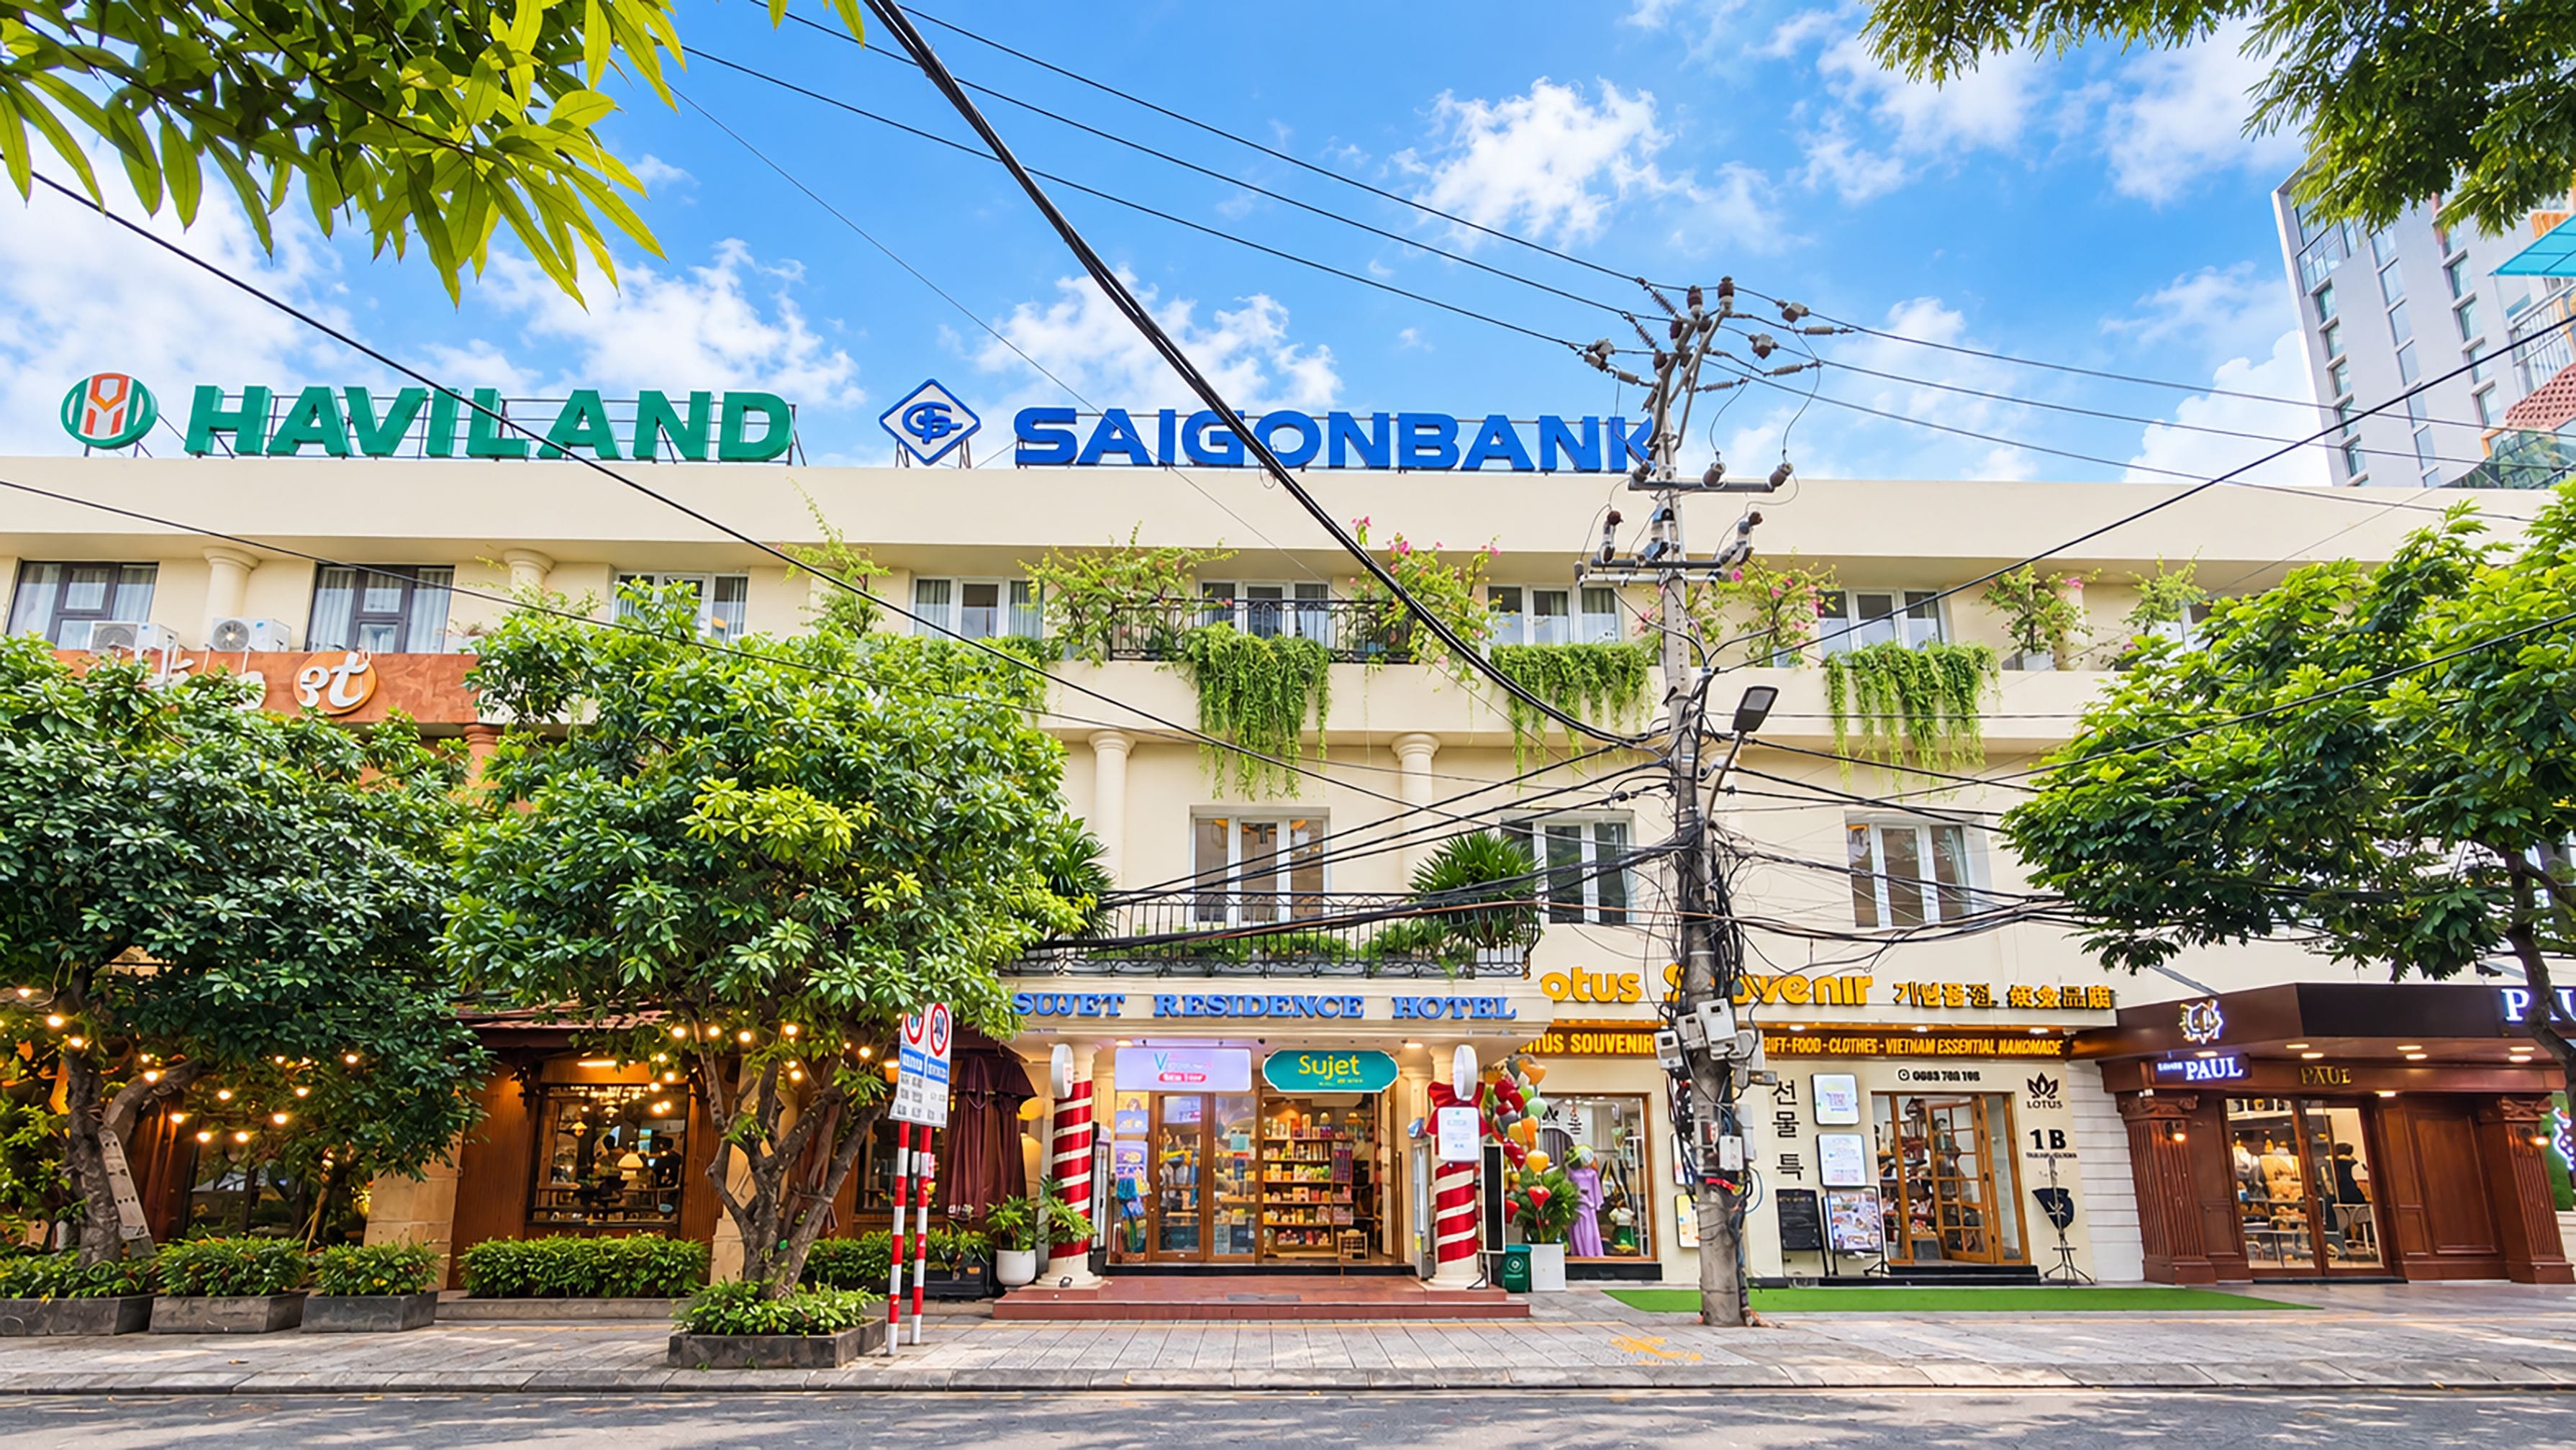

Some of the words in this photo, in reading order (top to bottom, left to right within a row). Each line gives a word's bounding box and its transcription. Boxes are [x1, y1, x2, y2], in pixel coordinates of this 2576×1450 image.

[186, 385, 794, 463] HAVILAND
[1013, 407, 1654, 473] SAIGONBANK
[1012, 993, 1125, 1016] SUJET
[1153, 994, 1364, 1018] RESIDENCE
[1392, 997, 1517, 1019] HOTEL
[1828, 1037, 1878, 1054] CLOTHES
[1885, 1038, 1936, 1054] VIETNAM
[1298, 1054, 1361, 1081] Sujet
[2185, 1057, 2244, 1080] PAUL
[2301, 1066, 2351, 1084] PAUL
[2026, 1100, 2063, 1109] LOTUS
[2029, 1129, 2067, 1150] 1B
[1776, 1154, 1804, 1180] 특
